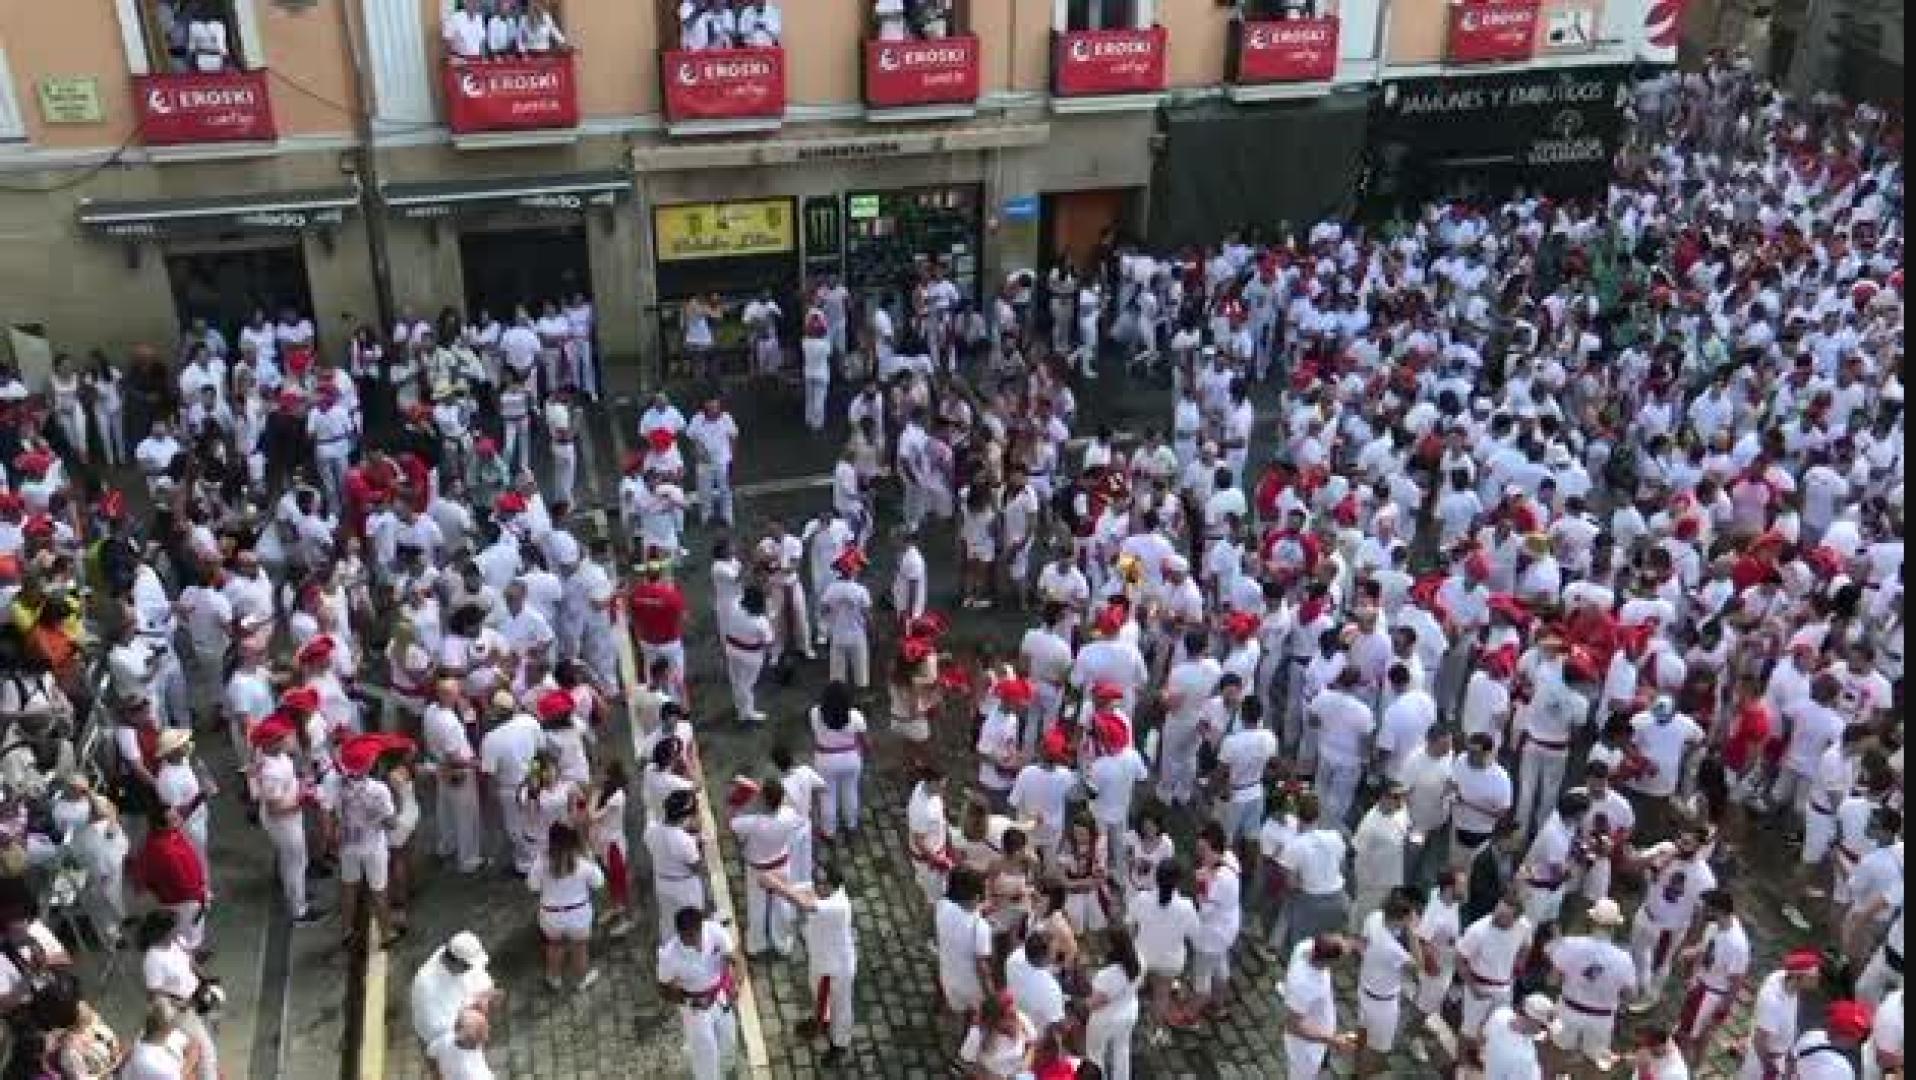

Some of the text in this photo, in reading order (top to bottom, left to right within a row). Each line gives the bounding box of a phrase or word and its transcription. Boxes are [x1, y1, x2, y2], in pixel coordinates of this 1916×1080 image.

[1271, 29, 1326, 45] EROSKI
[904, 48, 966, 65] EROSKI
[1094, 41, 1151, 56] EROSKI
[703, 61, 771, 79] EROSKI
[489, 73, 557, 92] EROSKI
[179, 89, 255, 107] EROSKI
[1401, 82, 1604, 114] JAMONES Y EMBUTIDOS
